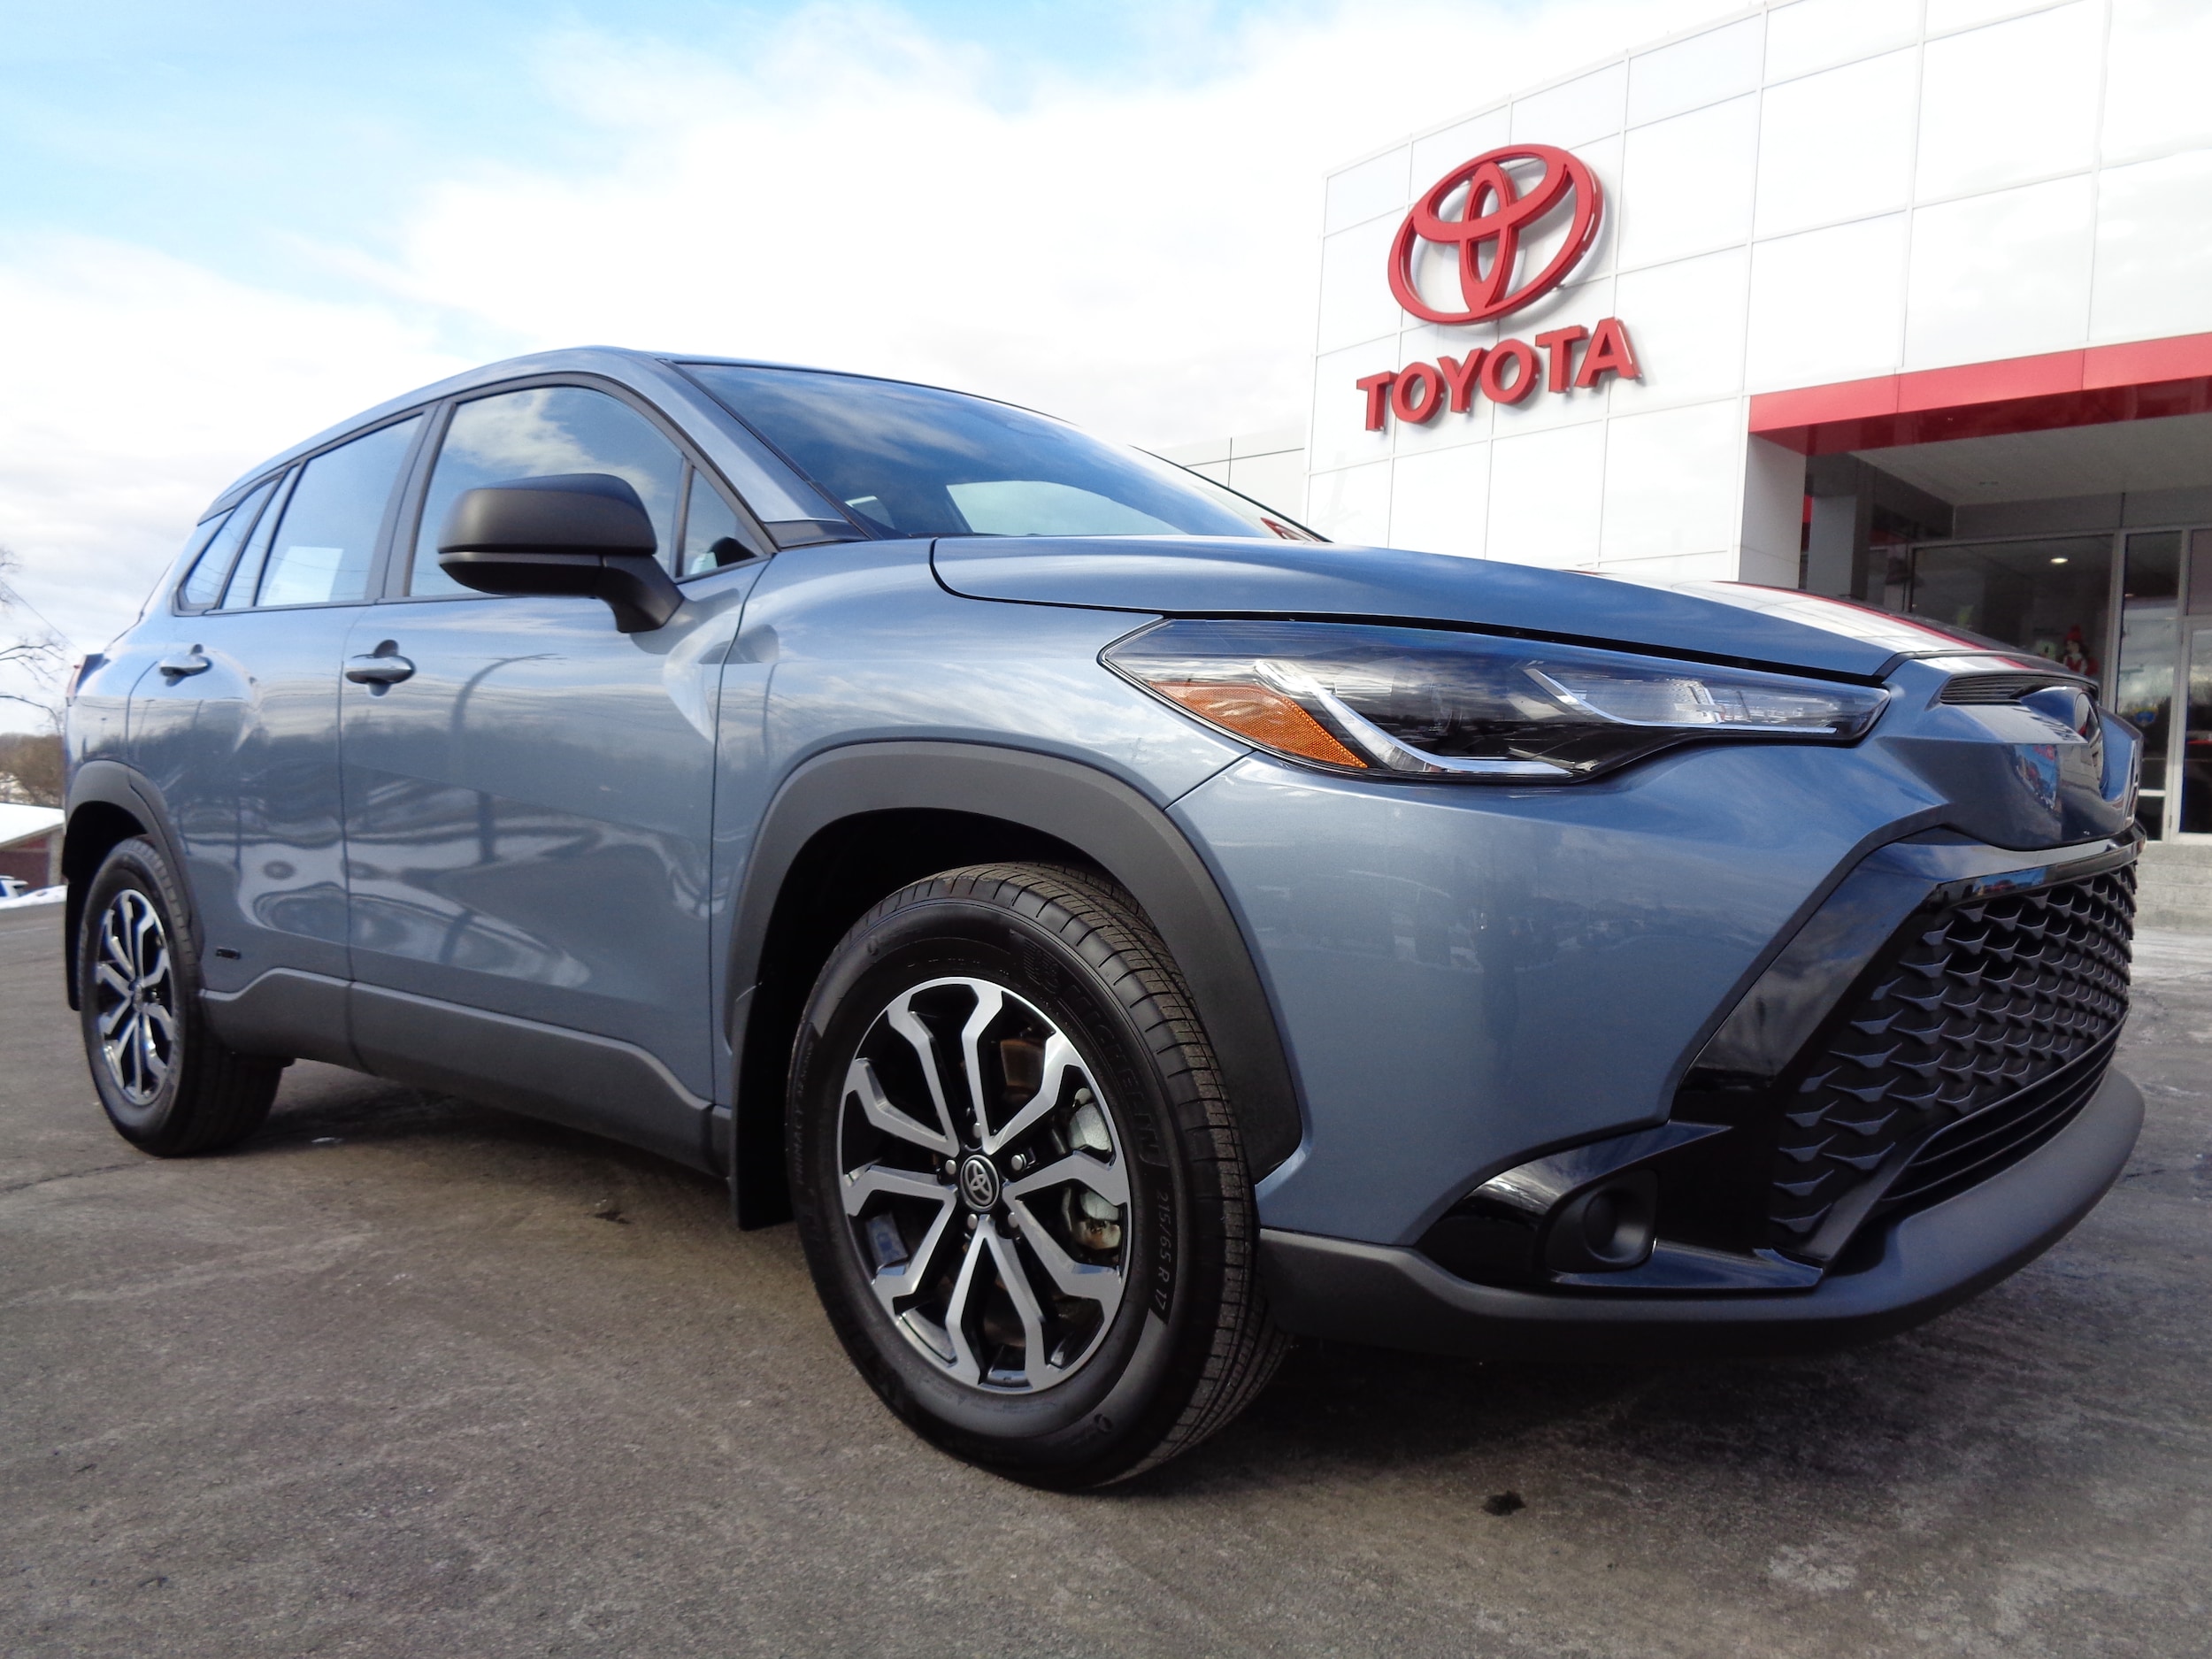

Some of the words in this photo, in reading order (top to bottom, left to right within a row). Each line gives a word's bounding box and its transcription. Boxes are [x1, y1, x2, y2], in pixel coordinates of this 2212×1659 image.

[1356, 317, 1641, 432] TOYOTA
[1062, 984, 1159, 1153] MICHELIN
[1156, 1190, 1171, 1263] 215/65
[1154, 1288, 1167, 1311] 17
[1157, 1265, 1170, 1284] R
